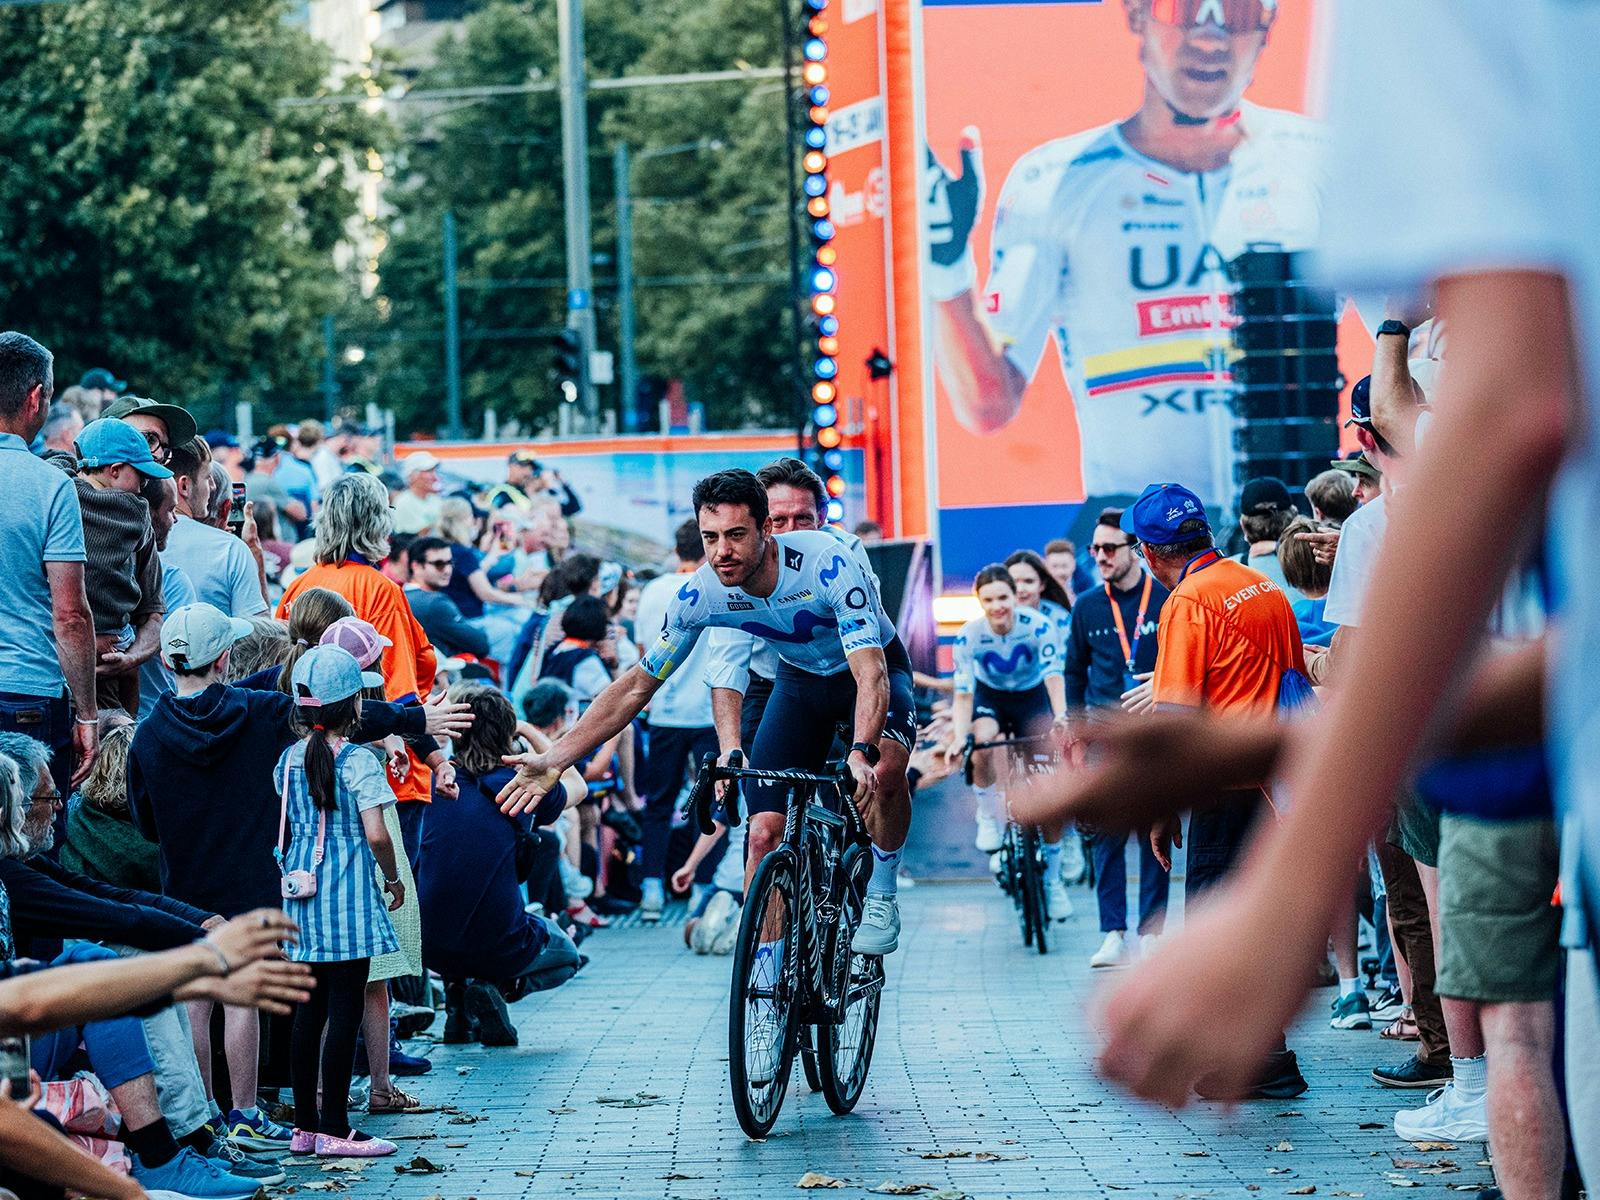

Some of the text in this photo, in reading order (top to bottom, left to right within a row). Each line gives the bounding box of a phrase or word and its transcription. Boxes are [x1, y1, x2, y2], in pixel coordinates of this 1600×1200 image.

[1130, 242, 1234, 292] UA
[778, 588, 812, 604] CANYON
[1224, 585, 1261, 610] EVENT
